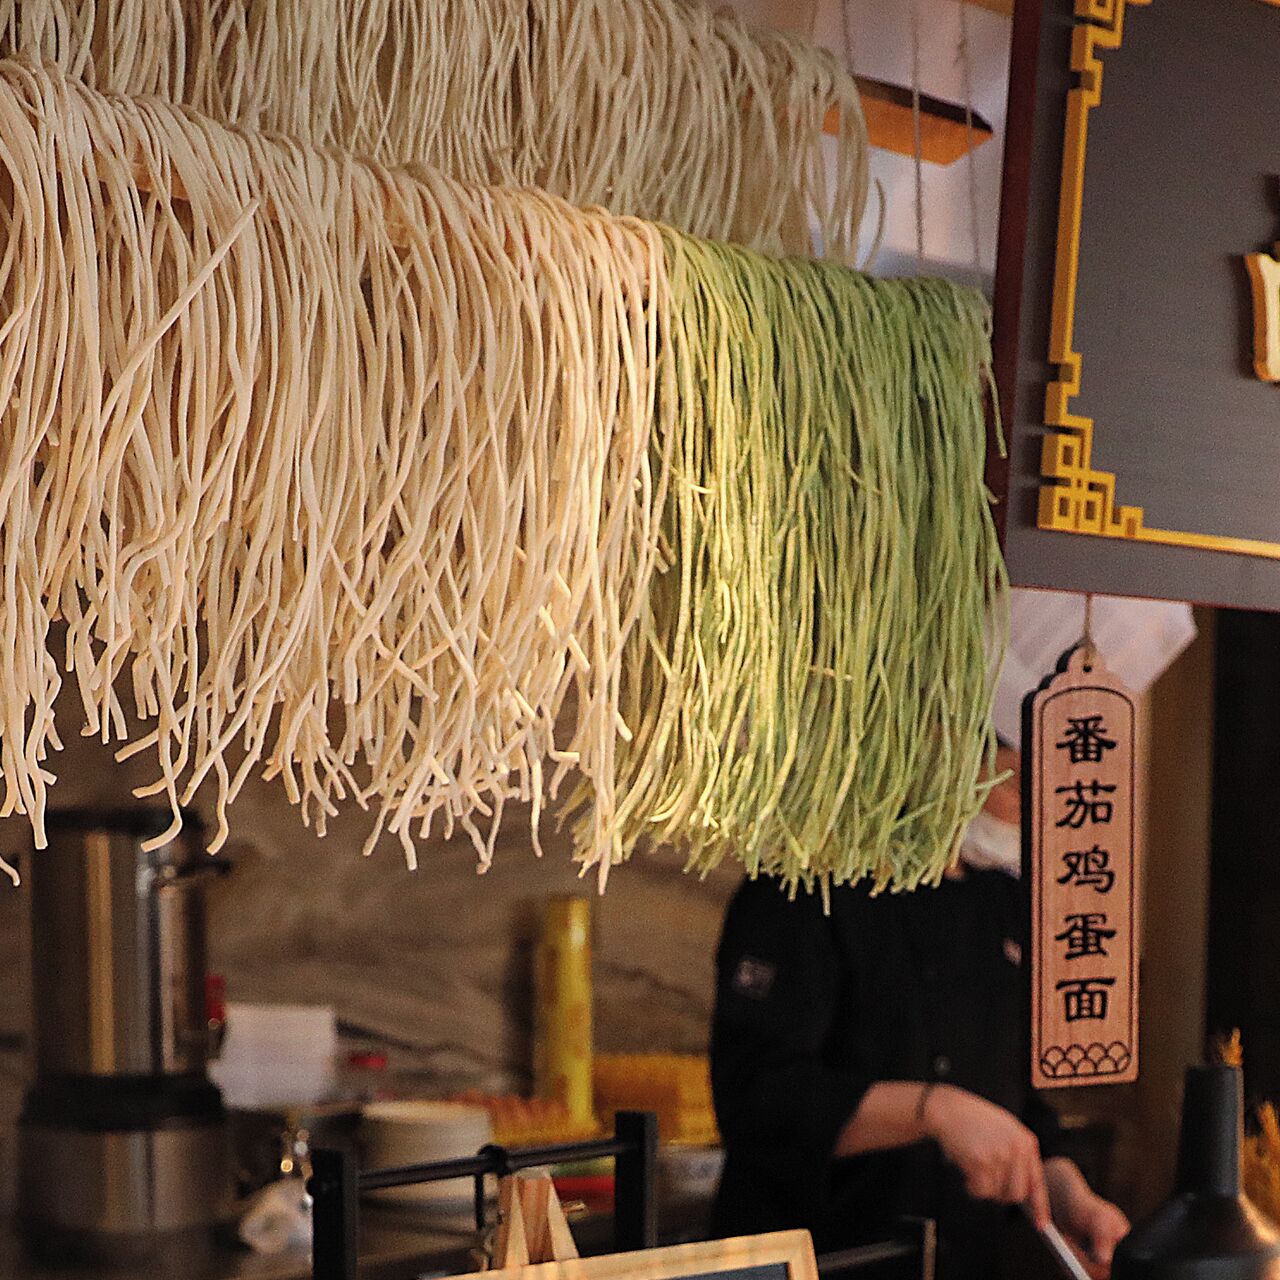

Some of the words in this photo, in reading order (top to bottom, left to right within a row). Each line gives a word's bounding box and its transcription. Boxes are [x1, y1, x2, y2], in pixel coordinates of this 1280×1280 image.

[1055, 714, 1118, 1024] 番茄鸡蛋面
